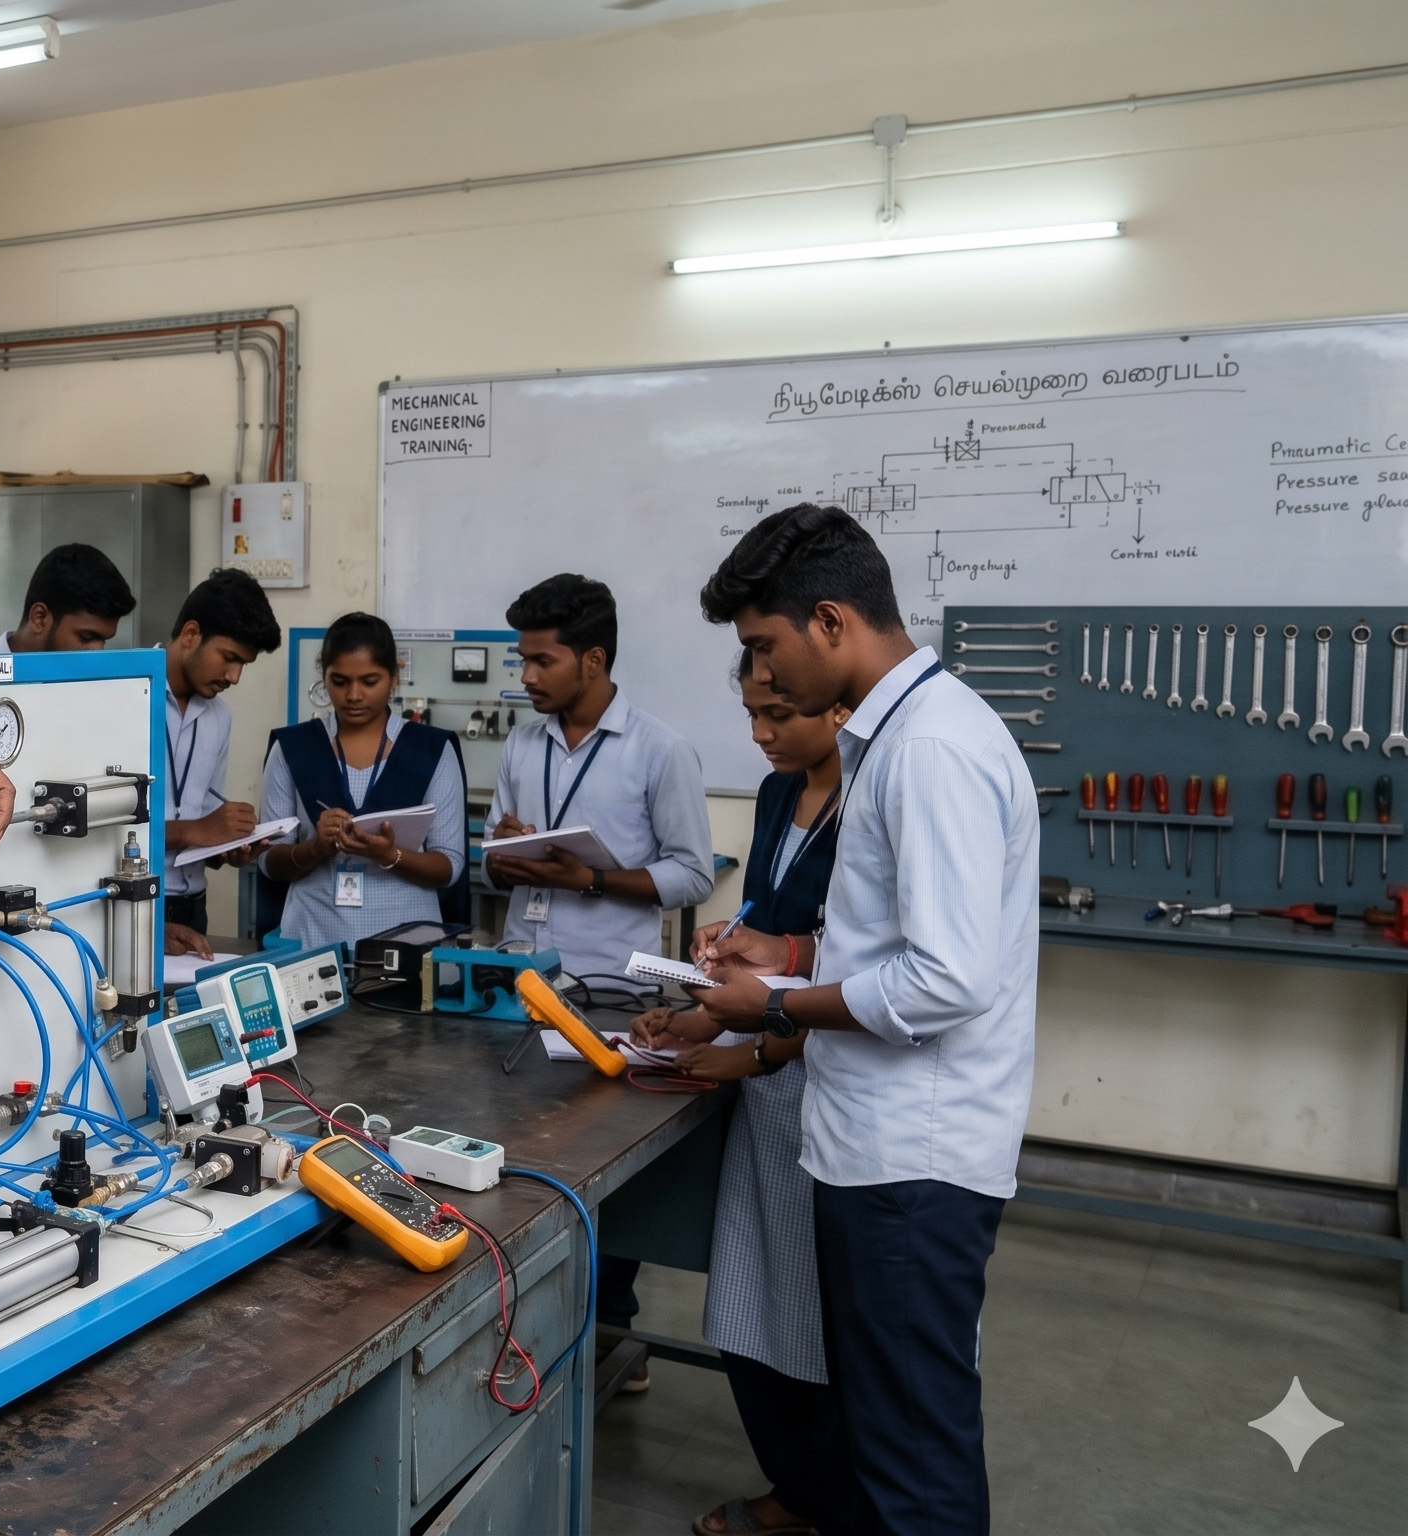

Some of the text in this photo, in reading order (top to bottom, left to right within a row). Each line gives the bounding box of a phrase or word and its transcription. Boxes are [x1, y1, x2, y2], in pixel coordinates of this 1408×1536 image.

[1102, 353, 1240, 389] வரைபடம்
[392, 392, 479, 411] MECHANICAL
[391, 413, 486, 434] ENGINEERING
[1276, 473, 1360, 491] Pressure
[1275, 499, 1350, 516] Pressure
